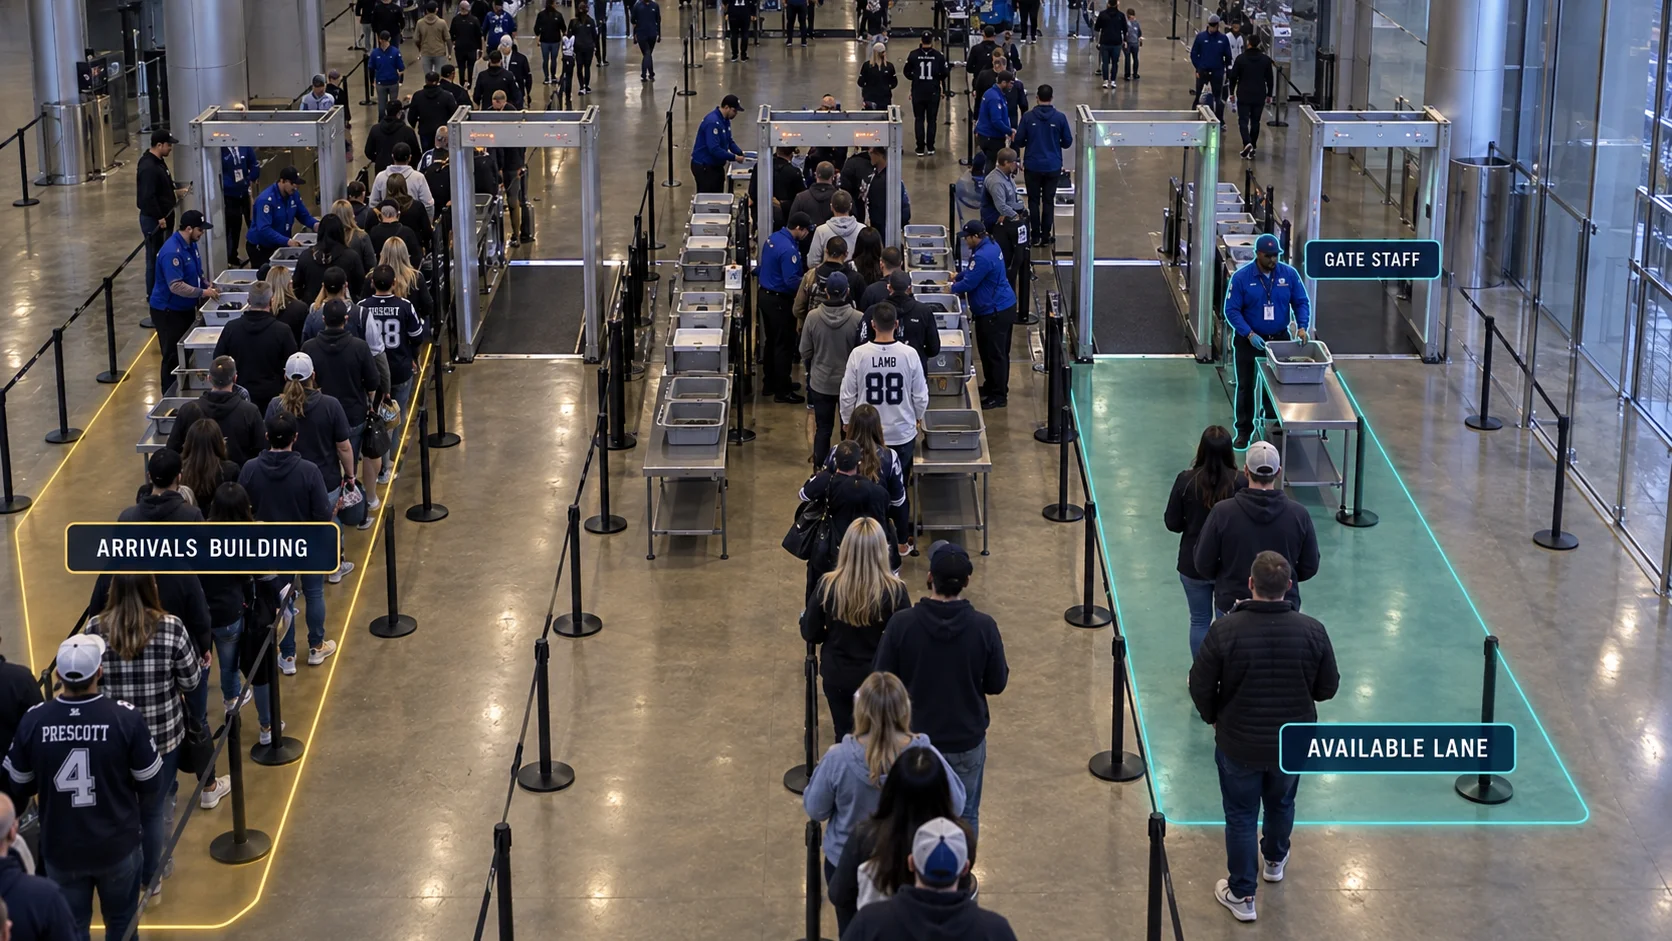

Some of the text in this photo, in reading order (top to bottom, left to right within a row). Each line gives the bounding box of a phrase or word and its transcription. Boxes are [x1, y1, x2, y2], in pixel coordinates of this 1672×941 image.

[919, 61, 933, 80] 11
[871, 356, 897, 368] LAMB
[865, 372, 904, 405] 88
[42, 724, 110, 743] PRESCOTT
[53, 747, 97, 808] 4
